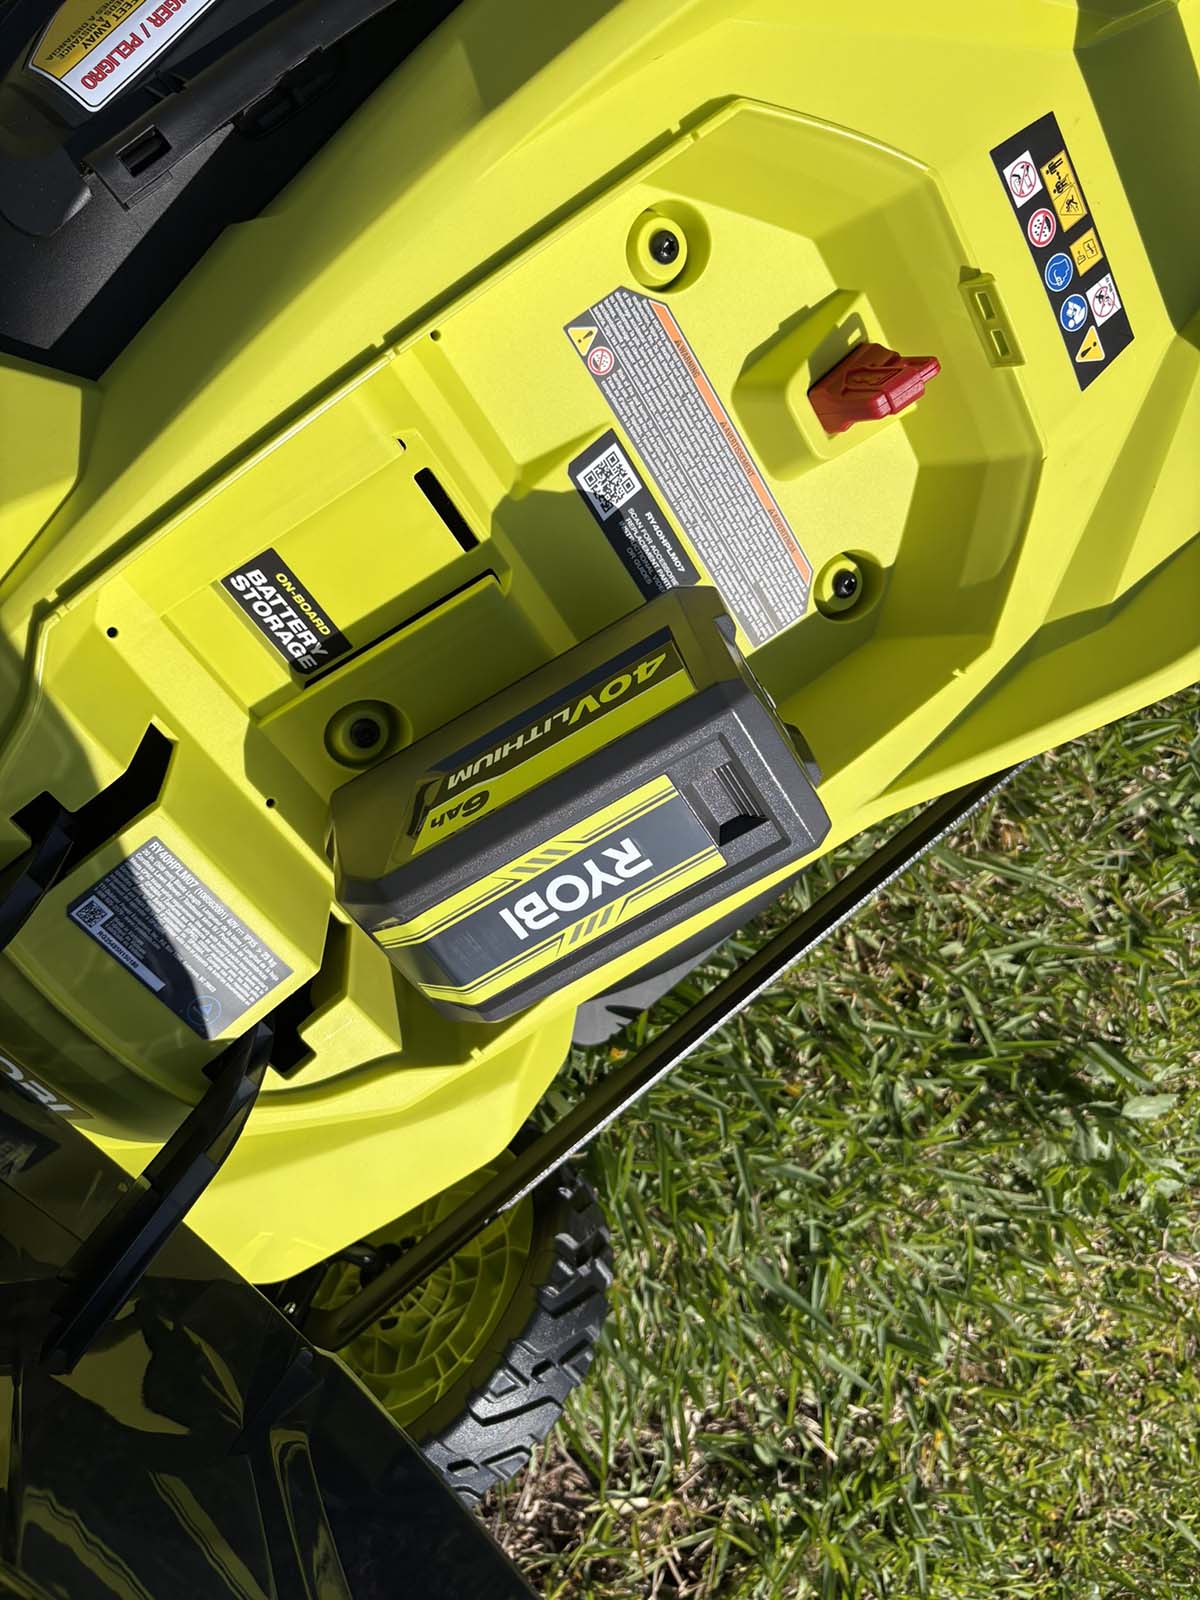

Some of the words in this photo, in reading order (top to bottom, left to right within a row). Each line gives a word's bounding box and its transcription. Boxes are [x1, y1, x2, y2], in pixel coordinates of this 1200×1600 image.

[83, 20, 112, 50] AWAY
[140, 23, 151, 38] /
[146, 0, 186, 28] GER
[45, 22, 88, 61] DISTANCIA
[59, 24, 99, 59] DISTANCE
[80, 32, 144, 89] PELIGRO
[677, 344, 701, 379] WARNING
[723, 427, 755, 478] AVERTISSEMENT
[628, 508, 644, 531] SCAN
[641, 528, 653, 545] FOR
[645, 512, 685, 572] RY40HPLM07
[625, 518, 660, 569] REPLACEMENT
[659, 568, 672, 590] PART
[633, 559, 653, 585] GUIDES
[230, 574, 317, 669] STORAGE
[245, 569, 328, 654] BATTERY
[275, 573, 331, 635] ON-BOARD
[447, 706, 570, 791] LITHIUM
[430, 789, 490, 829] 6Ah
[147, 840, 200, 889] RY40HPLM07
[498, 837, 654, 940] RYOBI
